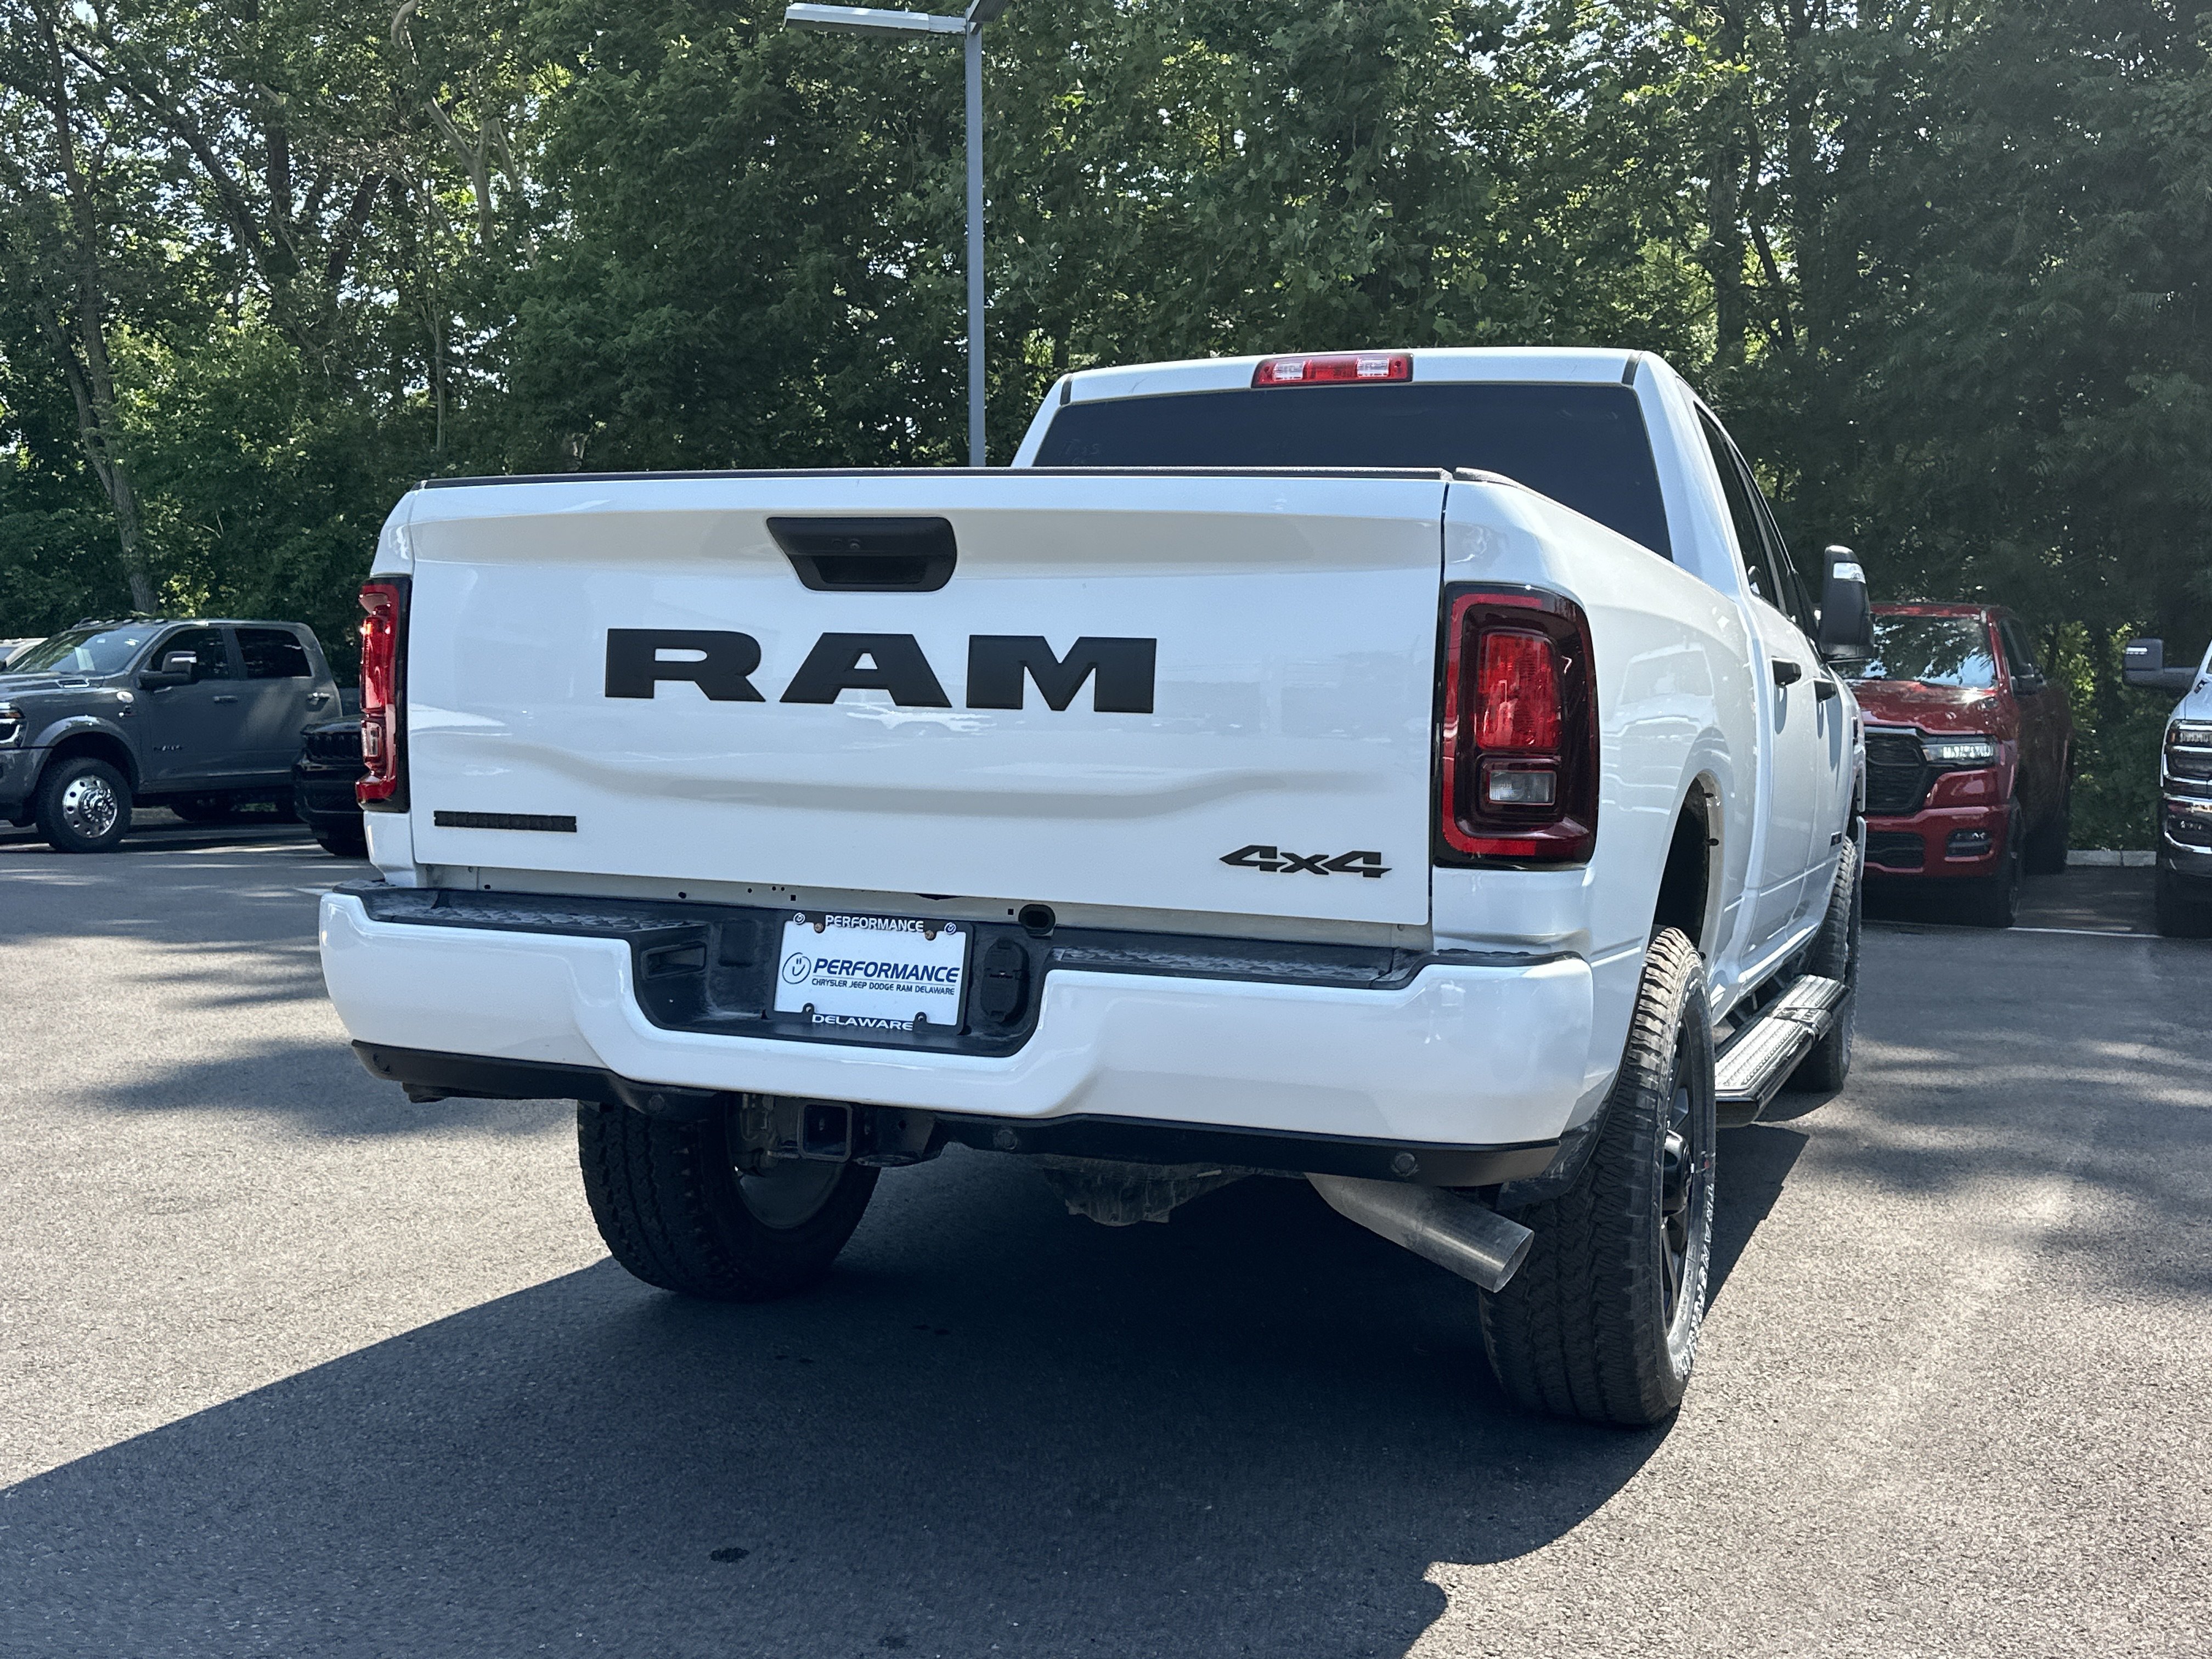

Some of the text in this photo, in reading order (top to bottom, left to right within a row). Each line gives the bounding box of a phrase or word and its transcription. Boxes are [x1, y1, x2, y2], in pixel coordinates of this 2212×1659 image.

[605, 628, 1157, 713] RAM
[1219, 845, 1392, 878] 4x4
[825, 915, 924, 932] PERFORMANCE
[813, 958, 960, 983] PERFORMANCE
[811, 978, 955, 995] CHRYSLER JEEP DODGE RAM DELAWARE
[812, 1014, 913, 1031] DELAWARE
